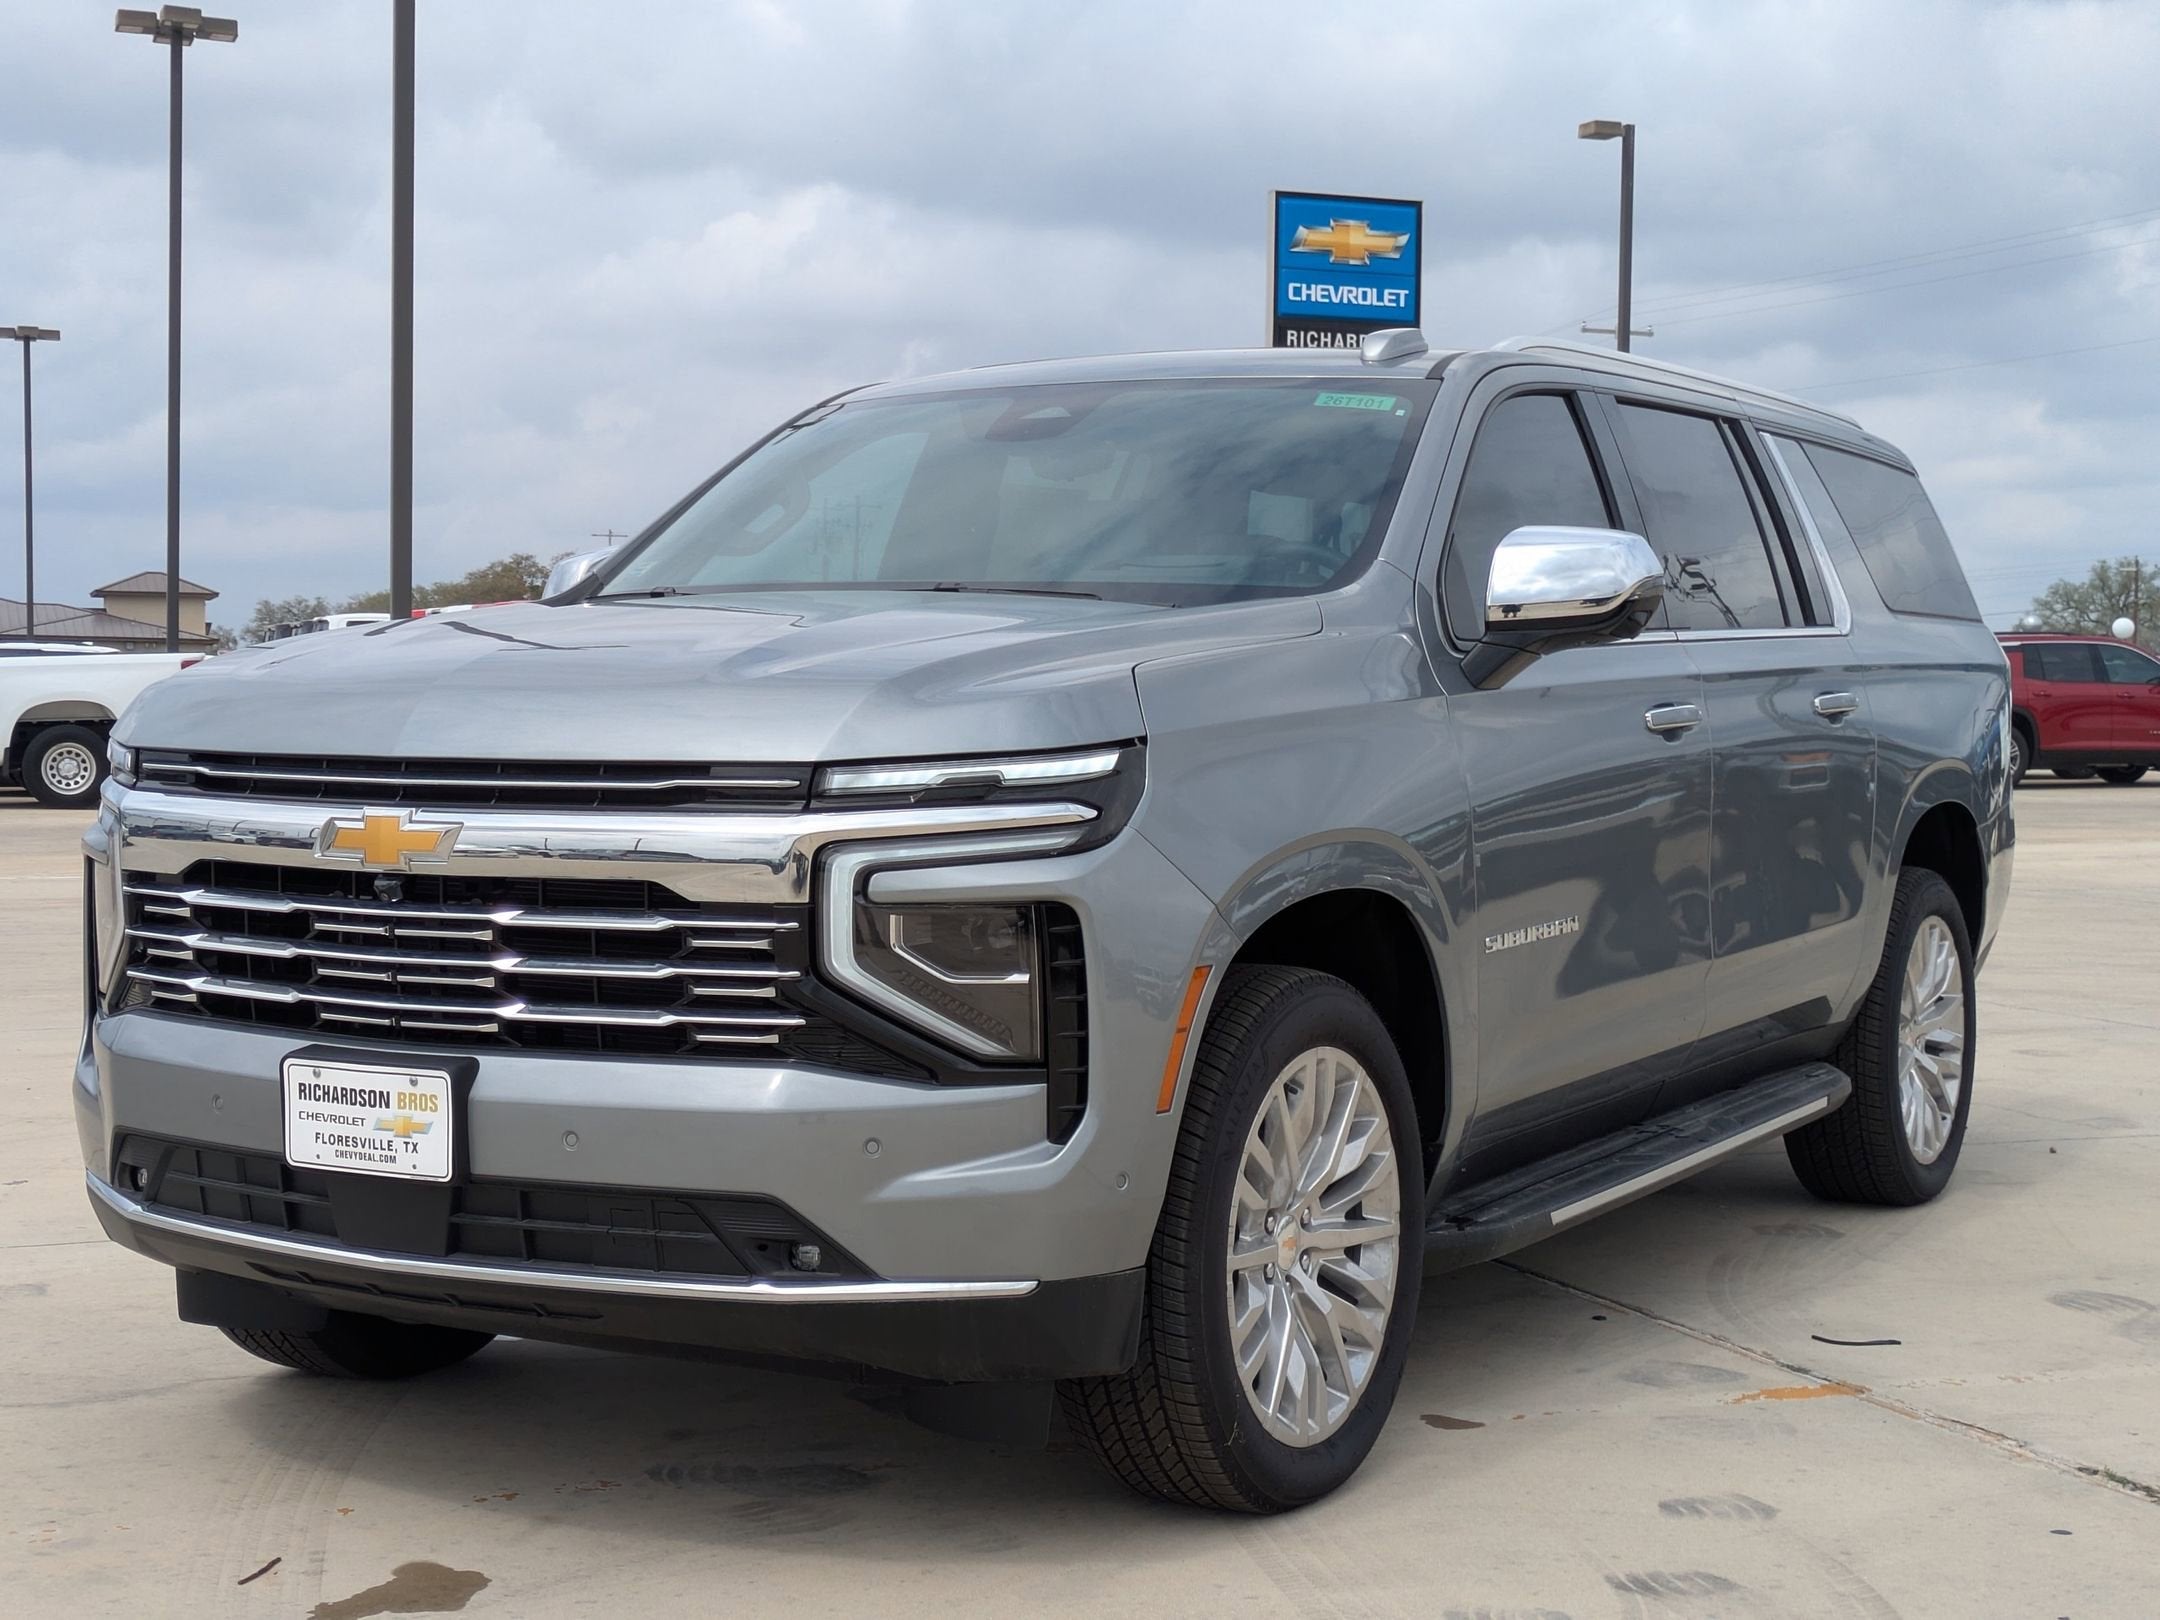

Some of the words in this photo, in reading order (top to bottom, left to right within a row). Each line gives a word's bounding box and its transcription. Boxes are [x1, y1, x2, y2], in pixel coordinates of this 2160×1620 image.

[1288, 282, 1409, 308] CHEVROLET
[1323, 395, 1385, 409] 26T101
[1485, 915, 1579, 954] SUBURBAN
[298, 1082, 390, 1109] RICHARDSON
[397, 1091, 438, 1113] BROS
[298, 1111, 366, 1127] CHEVROLET
[315, 1132, 398, 1154] FLORESVILLE,
[403, 1141, 419, 1154] TX
[335, 1149, 397, 1164] CHEVYDEAL.COM
